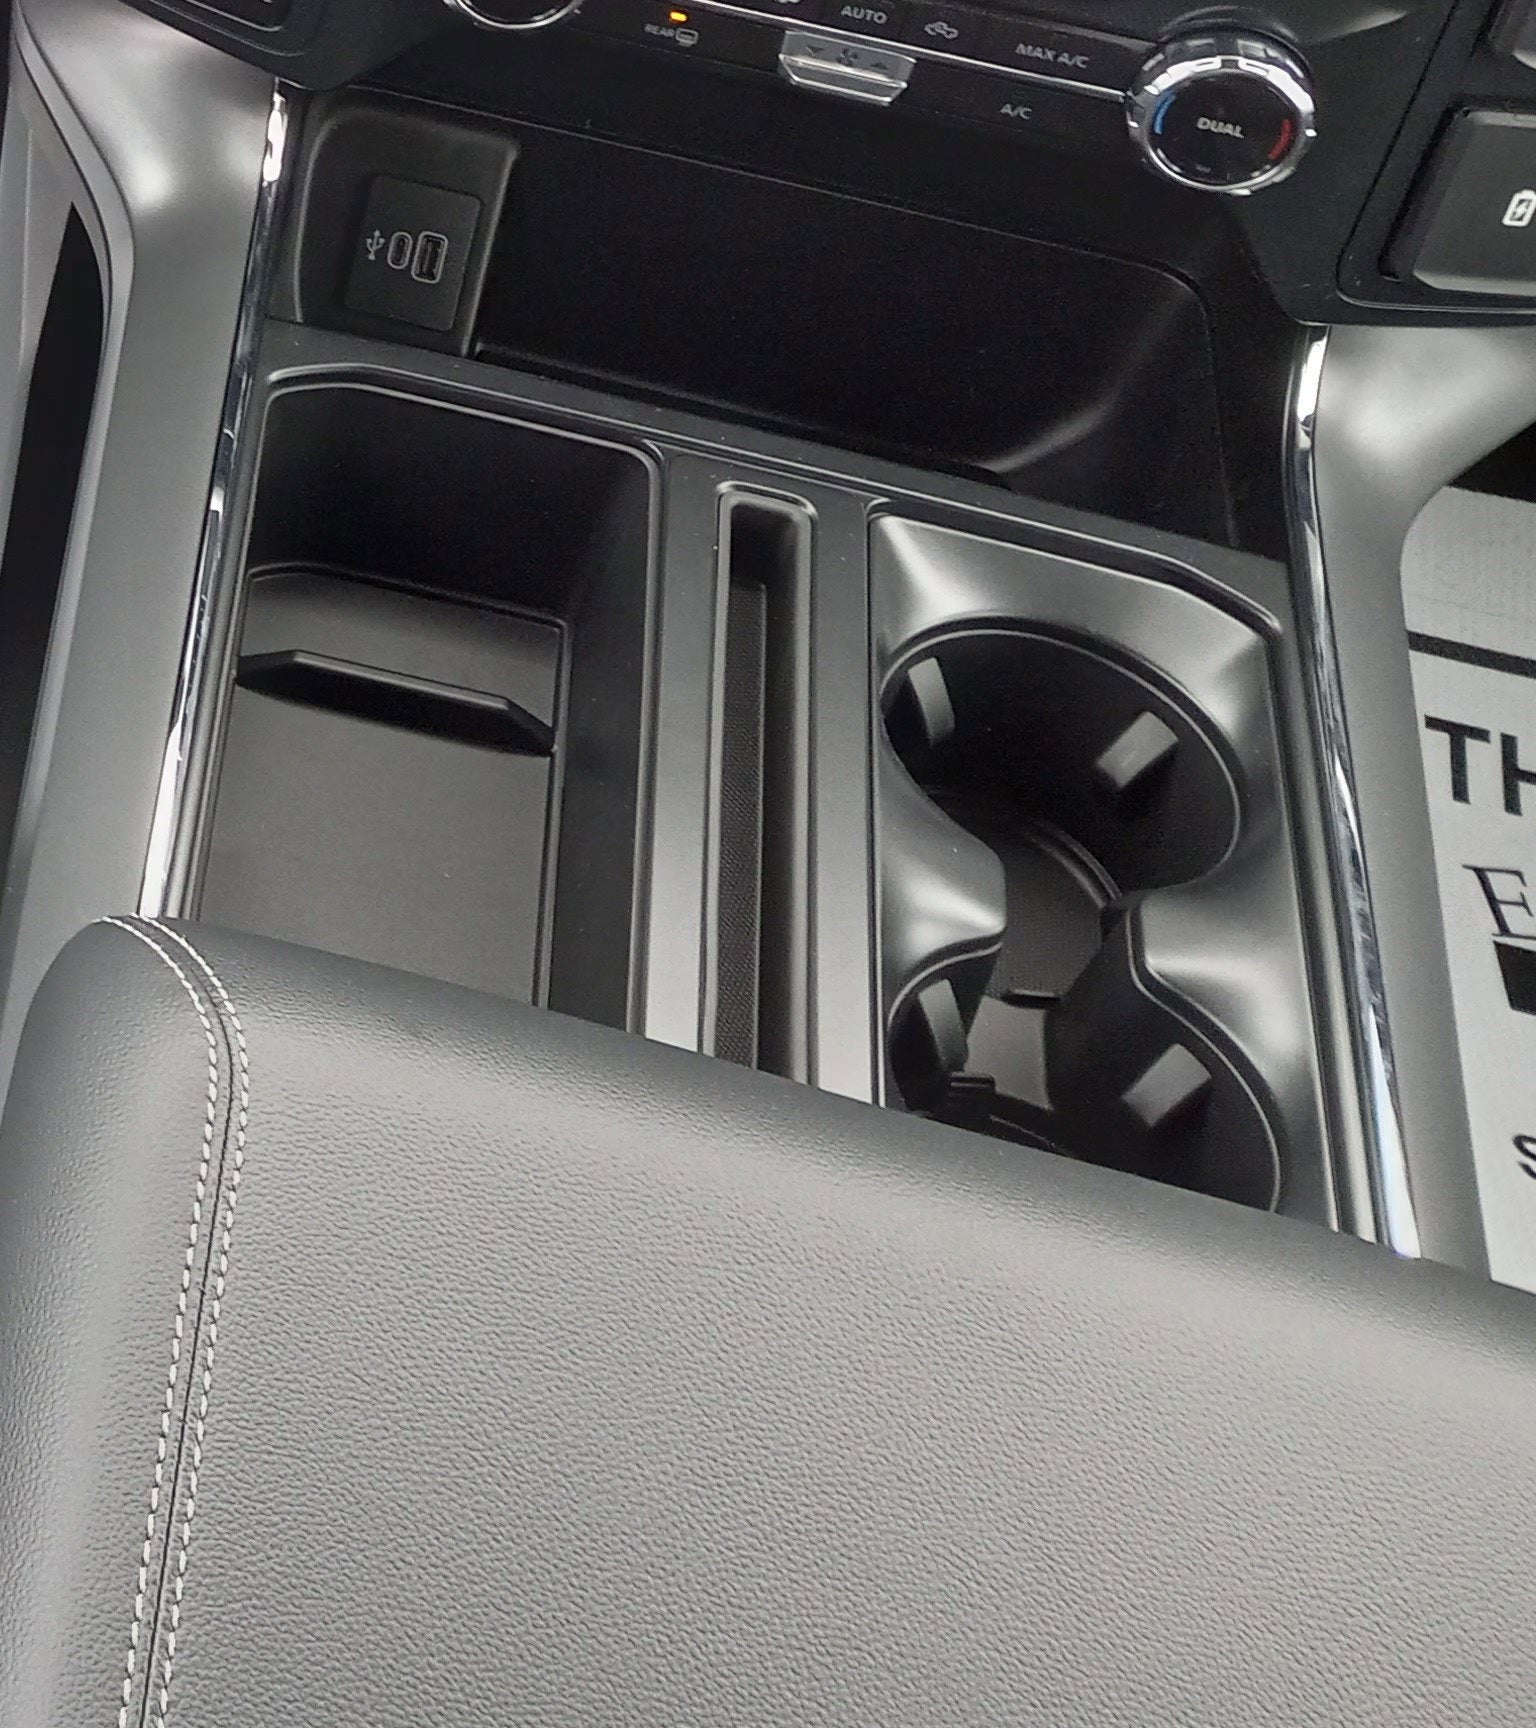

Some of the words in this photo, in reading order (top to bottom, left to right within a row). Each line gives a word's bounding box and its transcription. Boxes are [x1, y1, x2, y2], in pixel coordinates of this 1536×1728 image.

[840, 4, 888, 25] AUTO
[1014, 42, 1056, 63] MAX
[1057, 49, 1091, 70] A/C
[999, 102, 1033, 121] A/C
[1195, 116, 1246, 140] DUAL
